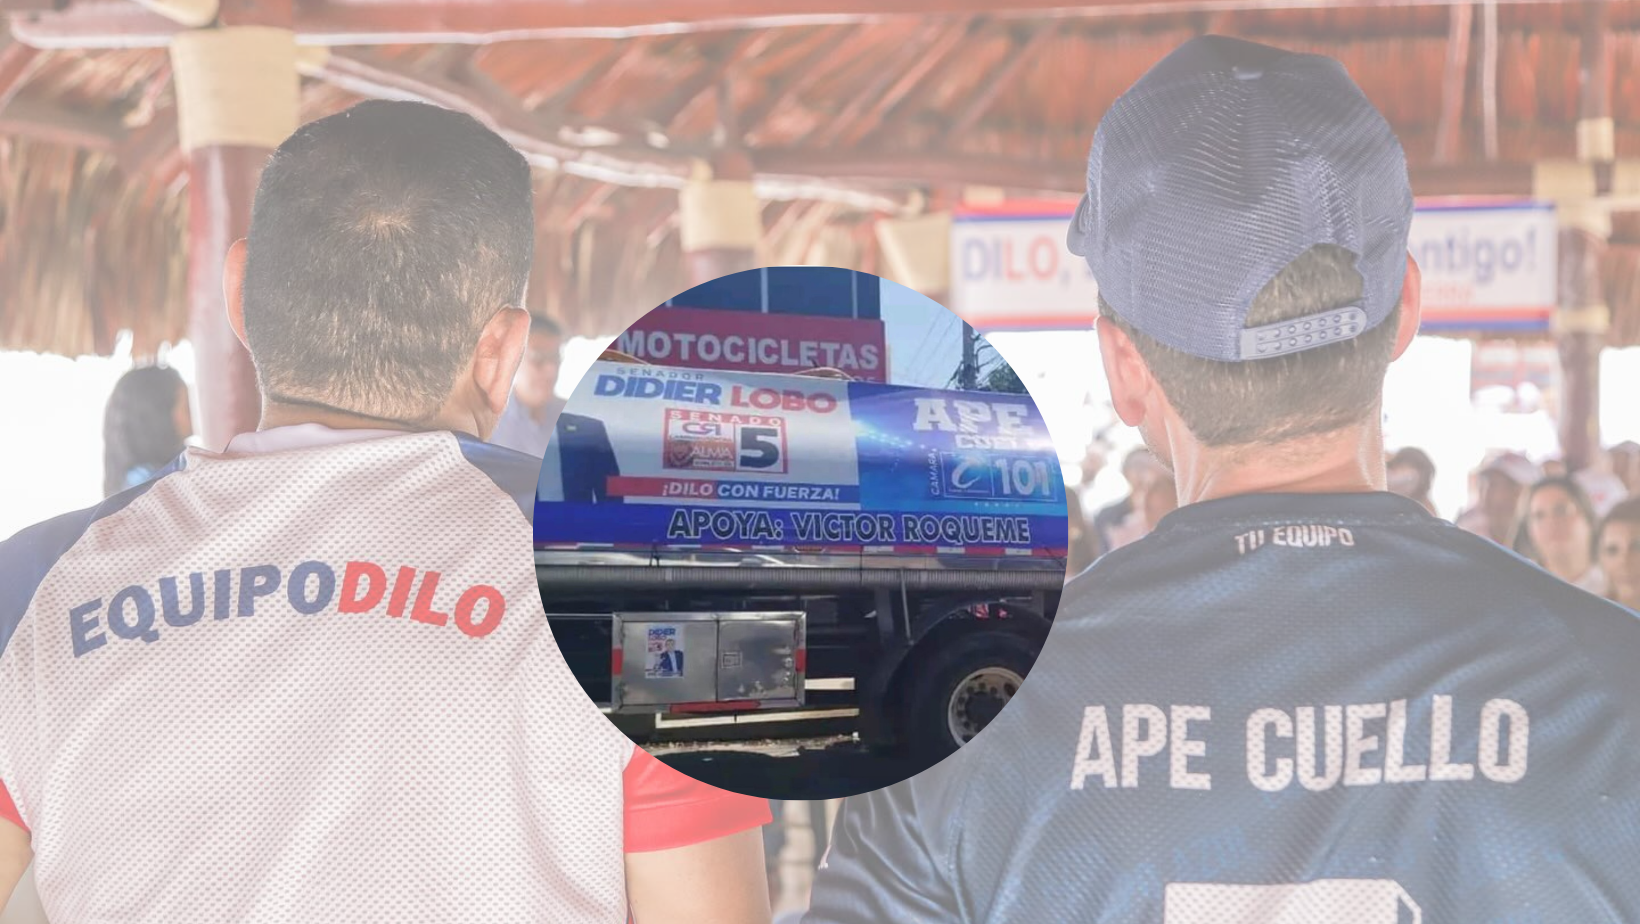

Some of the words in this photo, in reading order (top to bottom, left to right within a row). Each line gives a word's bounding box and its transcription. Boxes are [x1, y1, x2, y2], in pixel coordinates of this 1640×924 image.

[617, 330, 880, 370] MOTOCICLETAS
[616, 367, 705, 380] SENADOR
[593, 375, 722, 405] DIDIER
[730, 386, 837, 413] LOBO
[670, 411, 781, 427] SENADO
[913, 398, 1034, 437] APE
[740, 427, 780, 469] 5
[662, 482, 714, 497] ¡DILO
[717, 484, 759, 498] CON
[763, 486, 840, 501] FUERZA!
[995, 459, 1051, 496] 101
[666, 508, 784, 541] APOYA:
[790, 511, 896, 542] VICTOR
[903, 515, 1032, 545] ROQUEME
[1272, 524, 1355, 548] EQUIPO
[69, 560, 506, 658] EQUIPODILO
[1070, 703, 1212, 790] APE
[1245, 694, 1530, 792] CUELLO
